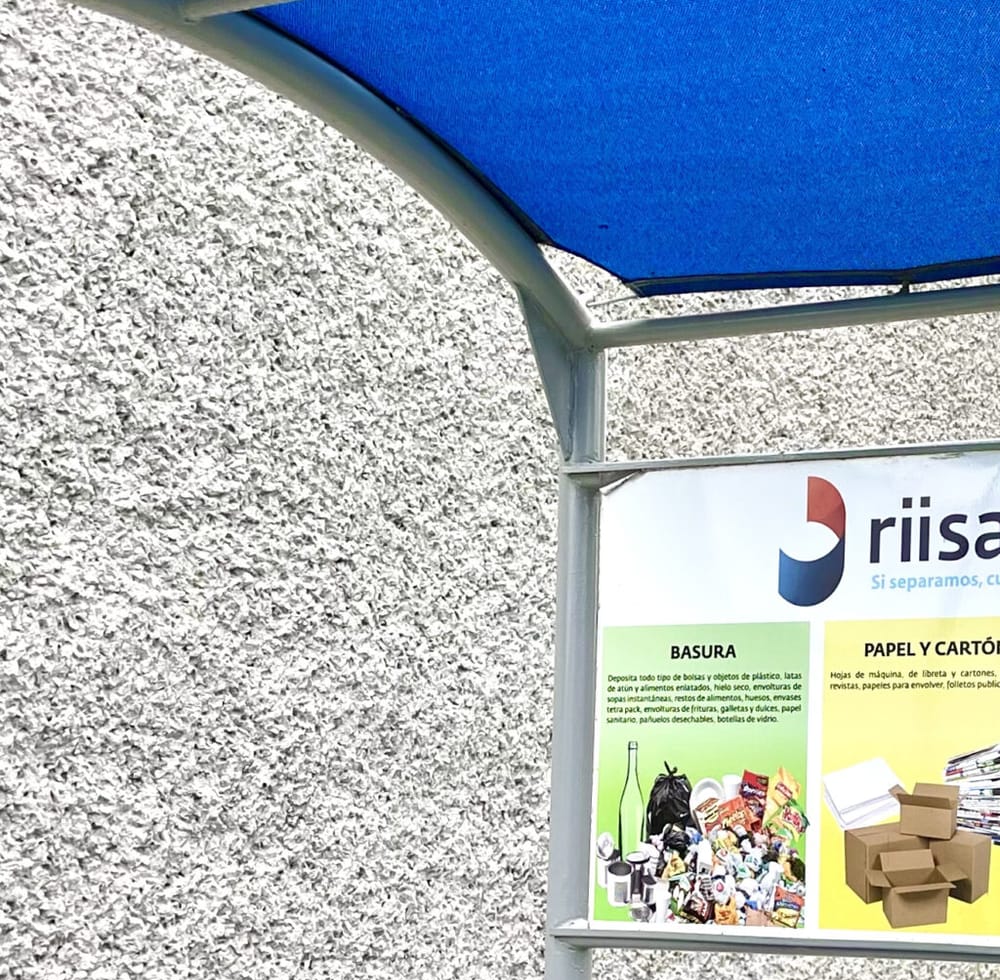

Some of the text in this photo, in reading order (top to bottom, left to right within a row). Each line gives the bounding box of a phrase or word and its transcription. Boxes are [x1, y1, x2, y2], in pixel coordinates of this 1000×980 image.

[871, 573, 884, 592] Si
[889, 570, 983, 591] separamos,
[671, 645, 736, 659] BASURA
[865, 642, 915, 657] PAPEL
[920, 642, 931, 656] Y
[608, 675, 637, 683] Deposita
[714, 673, 739, 682] objetos
[753, 672, 781, 681] plástico,
[830, 672, 851, 680] Hojas
[869, 670, 904, 679] máquina,
[909, 670, 918, 678] de
[714, 683, 731, 691] hielo
[862, 682, 890, 691] papeles
[911, 681, 944, 689] envolver,
[947, 680, 975, 689] folletos
[707, 694, 743, 702] alimentos,
[625, 706, 642, 714] pack,
[691, 705, 718, 713] frituras,
[721, 705, 748, 714] galletas
[782, 704, 801, 713] papel
[757, 715, 778, 723] vidrio.
